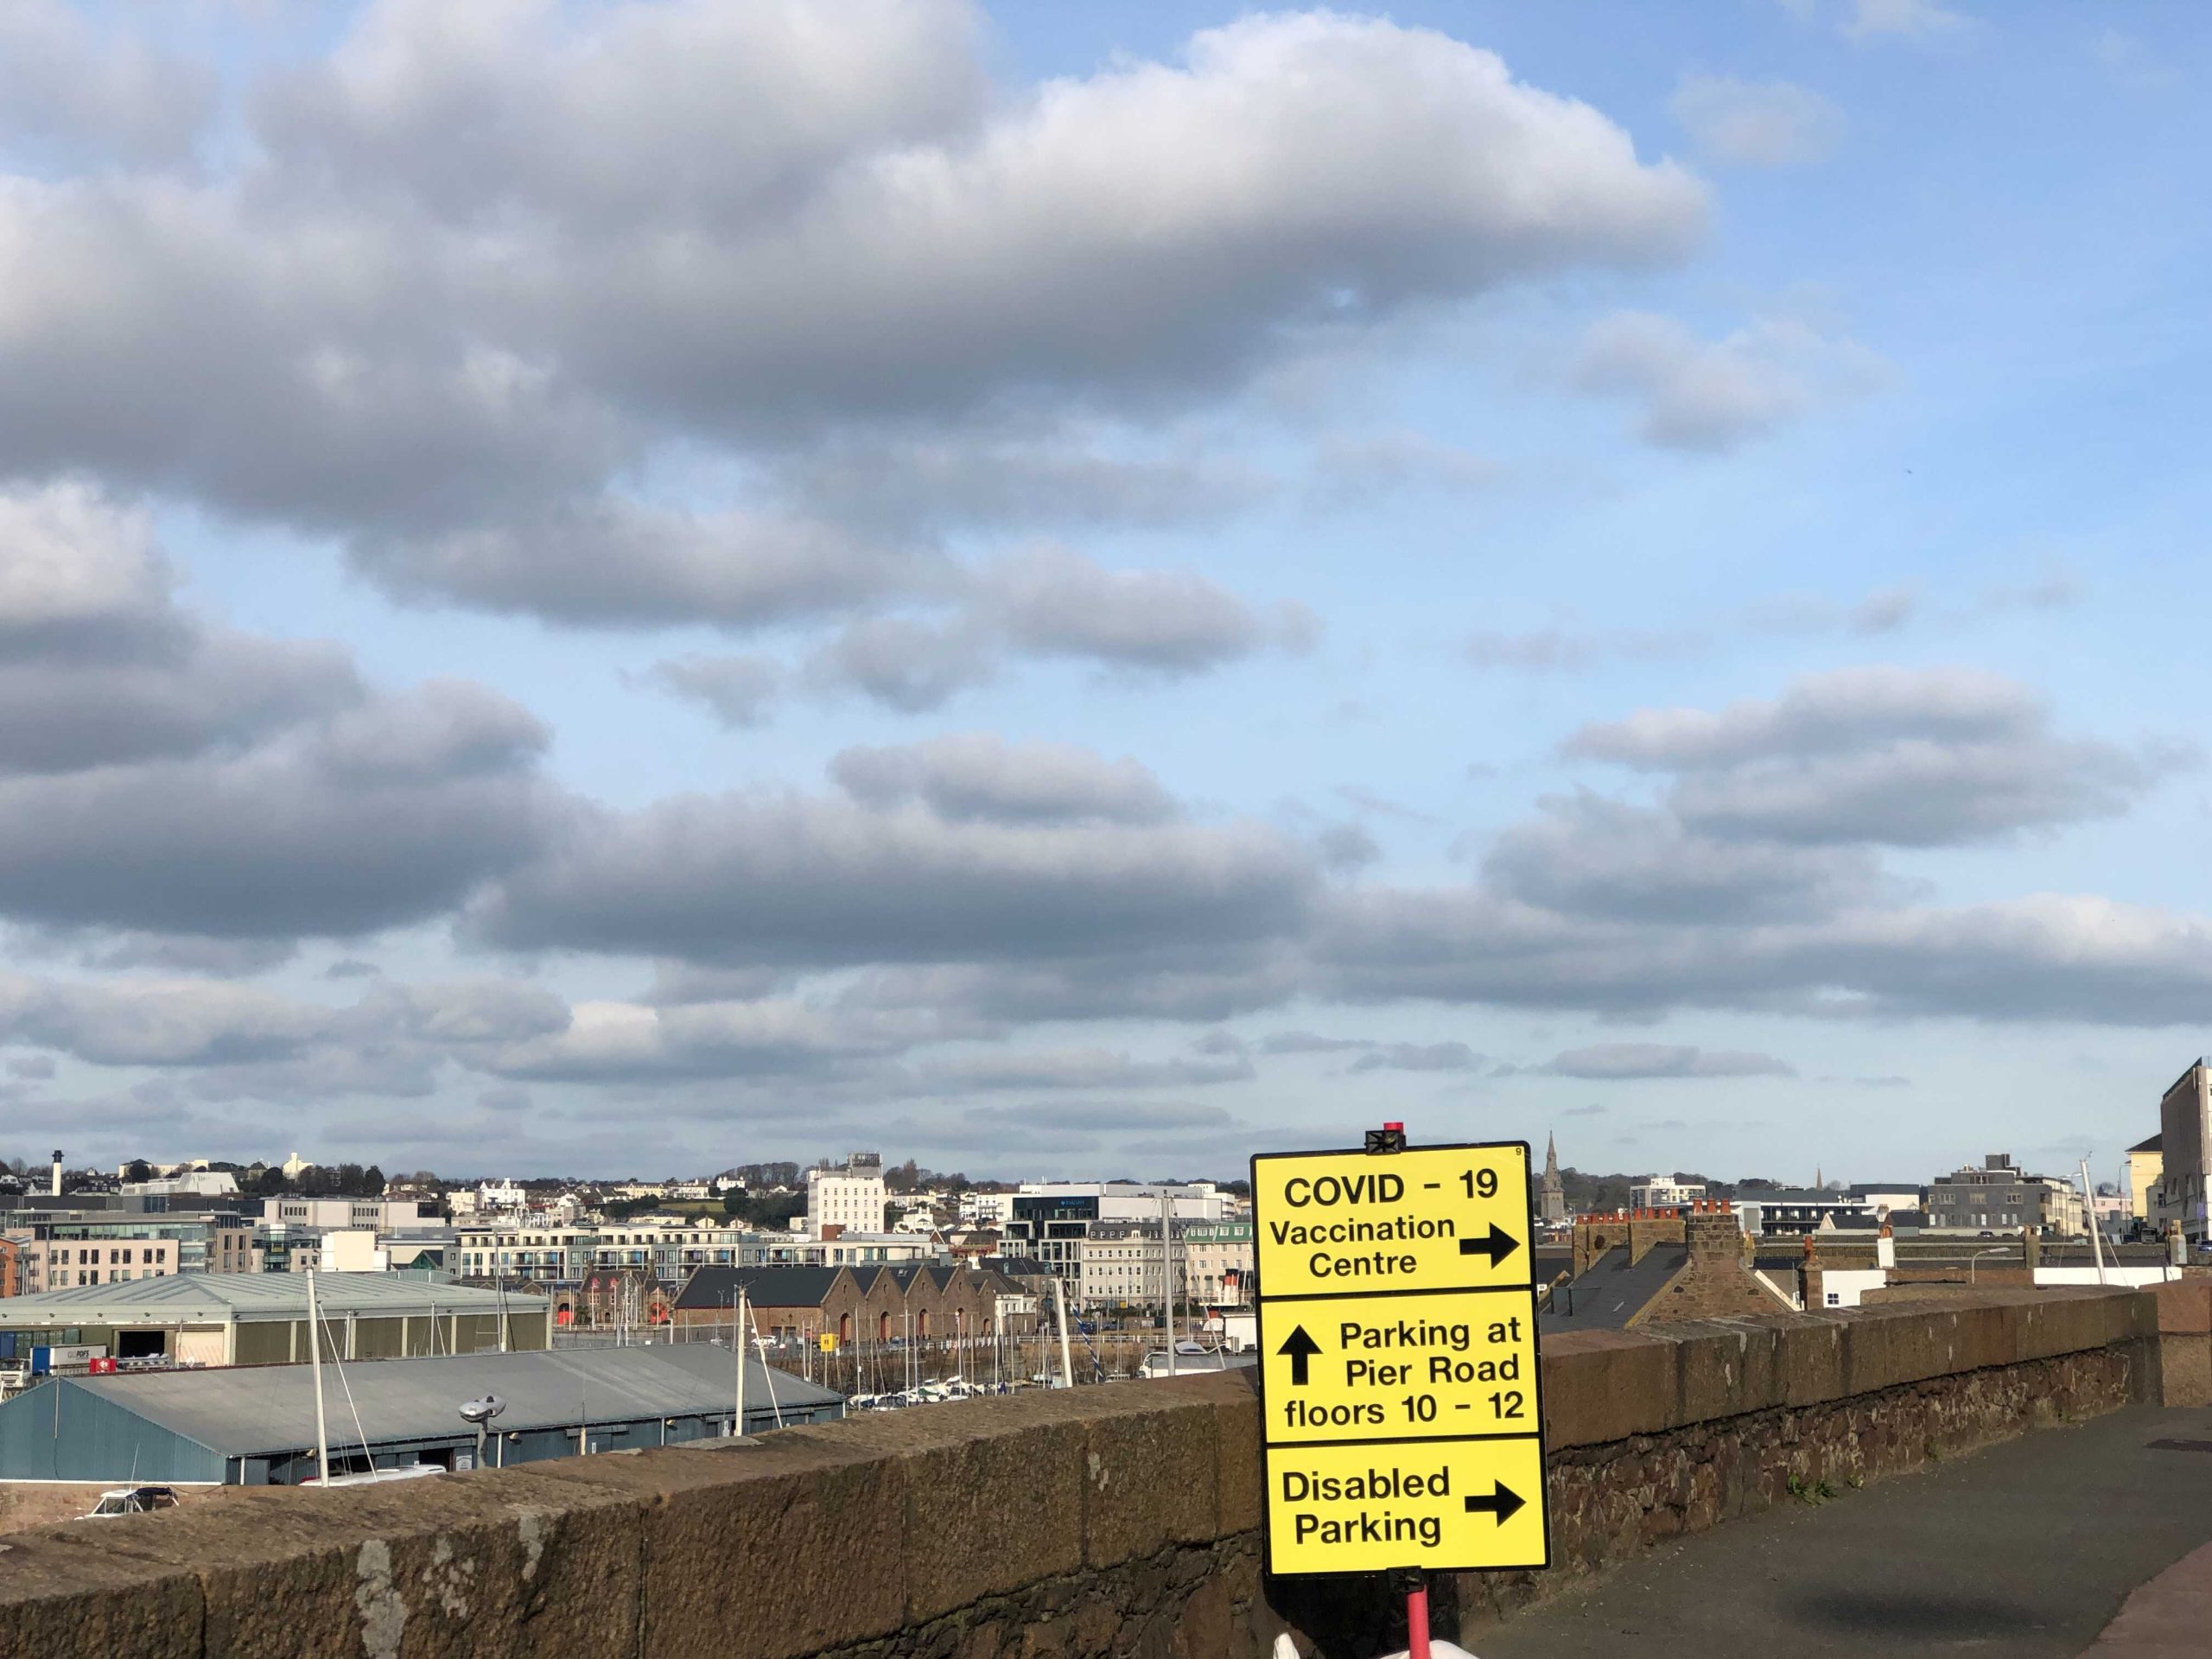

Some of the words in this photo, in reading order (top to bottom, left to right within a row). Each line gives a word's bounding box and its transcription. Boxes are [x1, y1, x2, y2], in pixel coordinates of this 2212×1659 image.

[1516, 1147, 1522, 1156] 9
[1284, 1173, 1405, 1208] COVID
[1459, 1168, 1498, 1199] 19
[1269, 1214, 1455, 1245] Vaccination
[1309, 1251, 1417, 1278] Centre
[1340, 1319, 1470, 1351] Parking
[1487, 1316, 1522, 1344] at
[1346, 1359, 1413, 1387] Pier
[1428, 1352, 1519, 1383] Road
[1284, 1400, 1385, 1427] floors
[1402, 1394, 1437, 1423] 10
[1488, 1390, 1524, 1419] 12
[1282, 1465, 1450, 1503] Disabled
[1295, 1510, 1441, 1548] Parking
